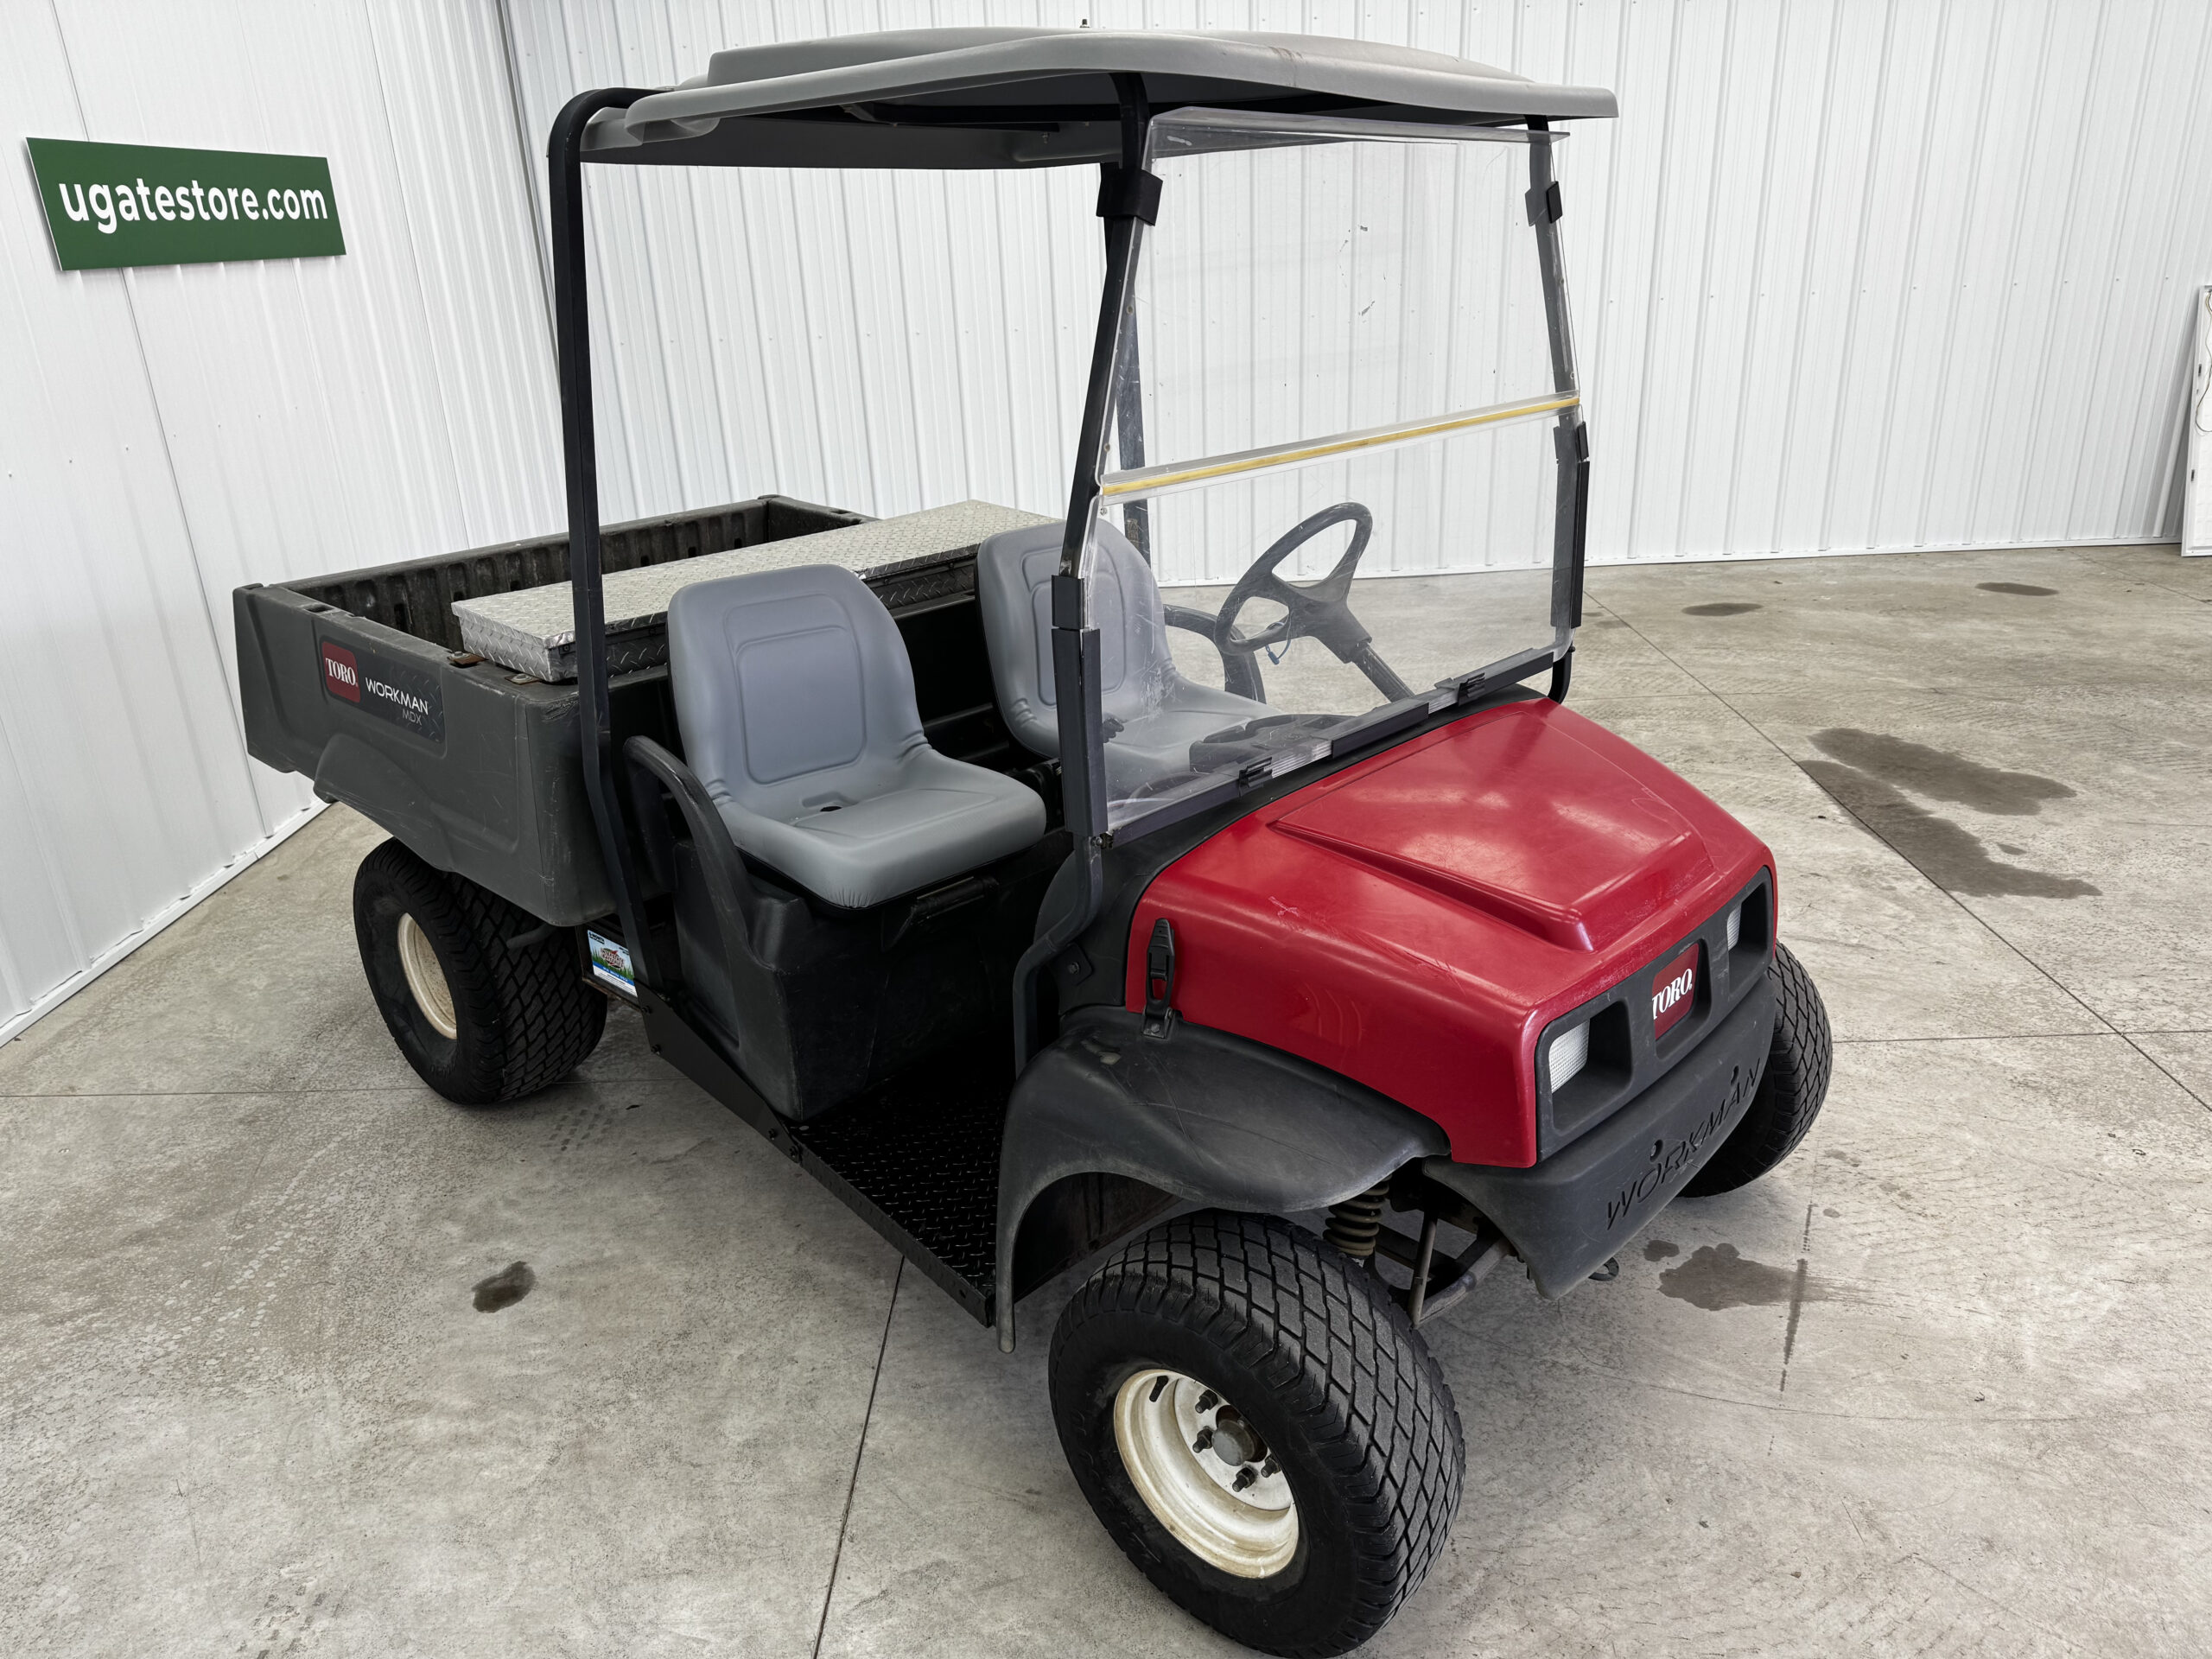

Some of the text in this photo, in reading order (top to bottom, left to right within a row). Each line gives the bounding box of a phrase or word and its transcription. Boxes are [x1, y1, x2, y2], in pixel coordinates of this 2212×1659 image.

[59, 178, 327, 234] ugatestore.com
[325, 658, 357, 687] TORO
[365, 677, 429, 715] WORKMAN
[402, 709, 423, 726] MDX
[1652, 968, 1693, 1020] TORO
[1606, 1057, 1761, 1231] WORKMAN
